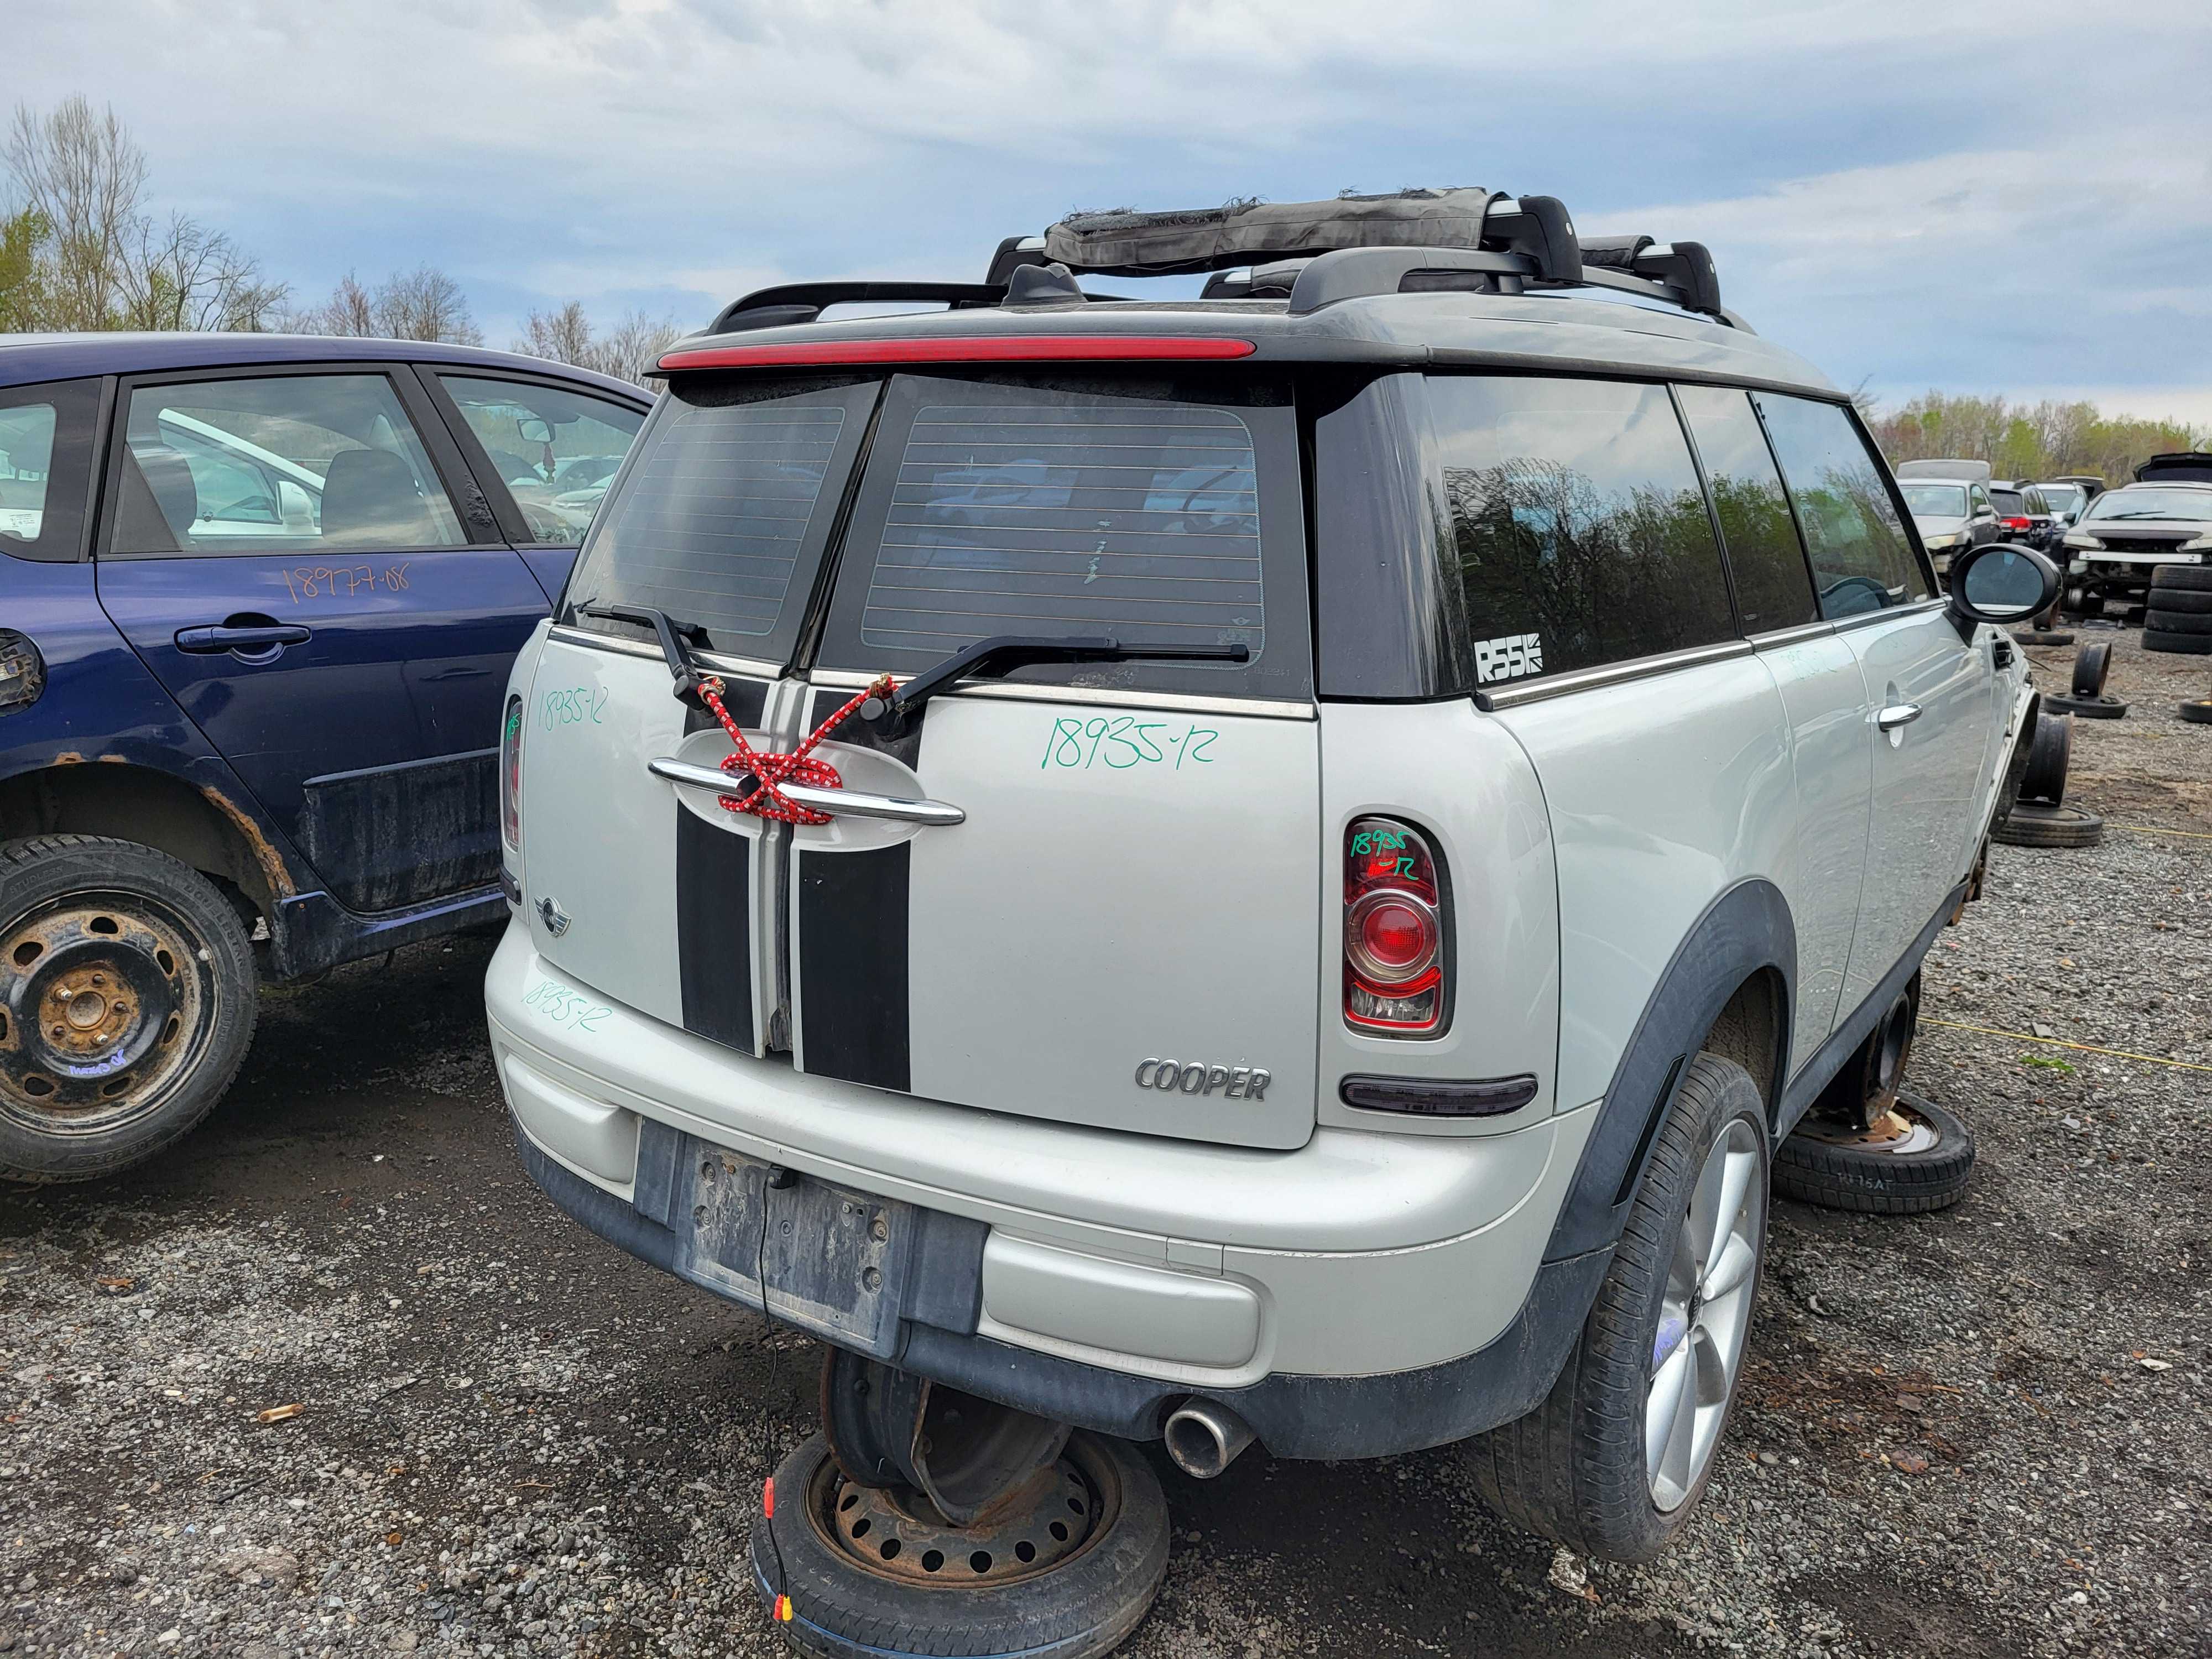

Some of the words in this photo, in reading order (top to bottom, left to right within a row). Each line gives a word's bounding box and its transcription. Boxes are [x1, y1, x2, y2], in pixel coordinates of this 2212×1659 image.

[538, 686, 609, 731] 18935-12
[1041, 717, 1218, 770] 18935-12
[1135, 1057, 1271, 1102] COOPER
